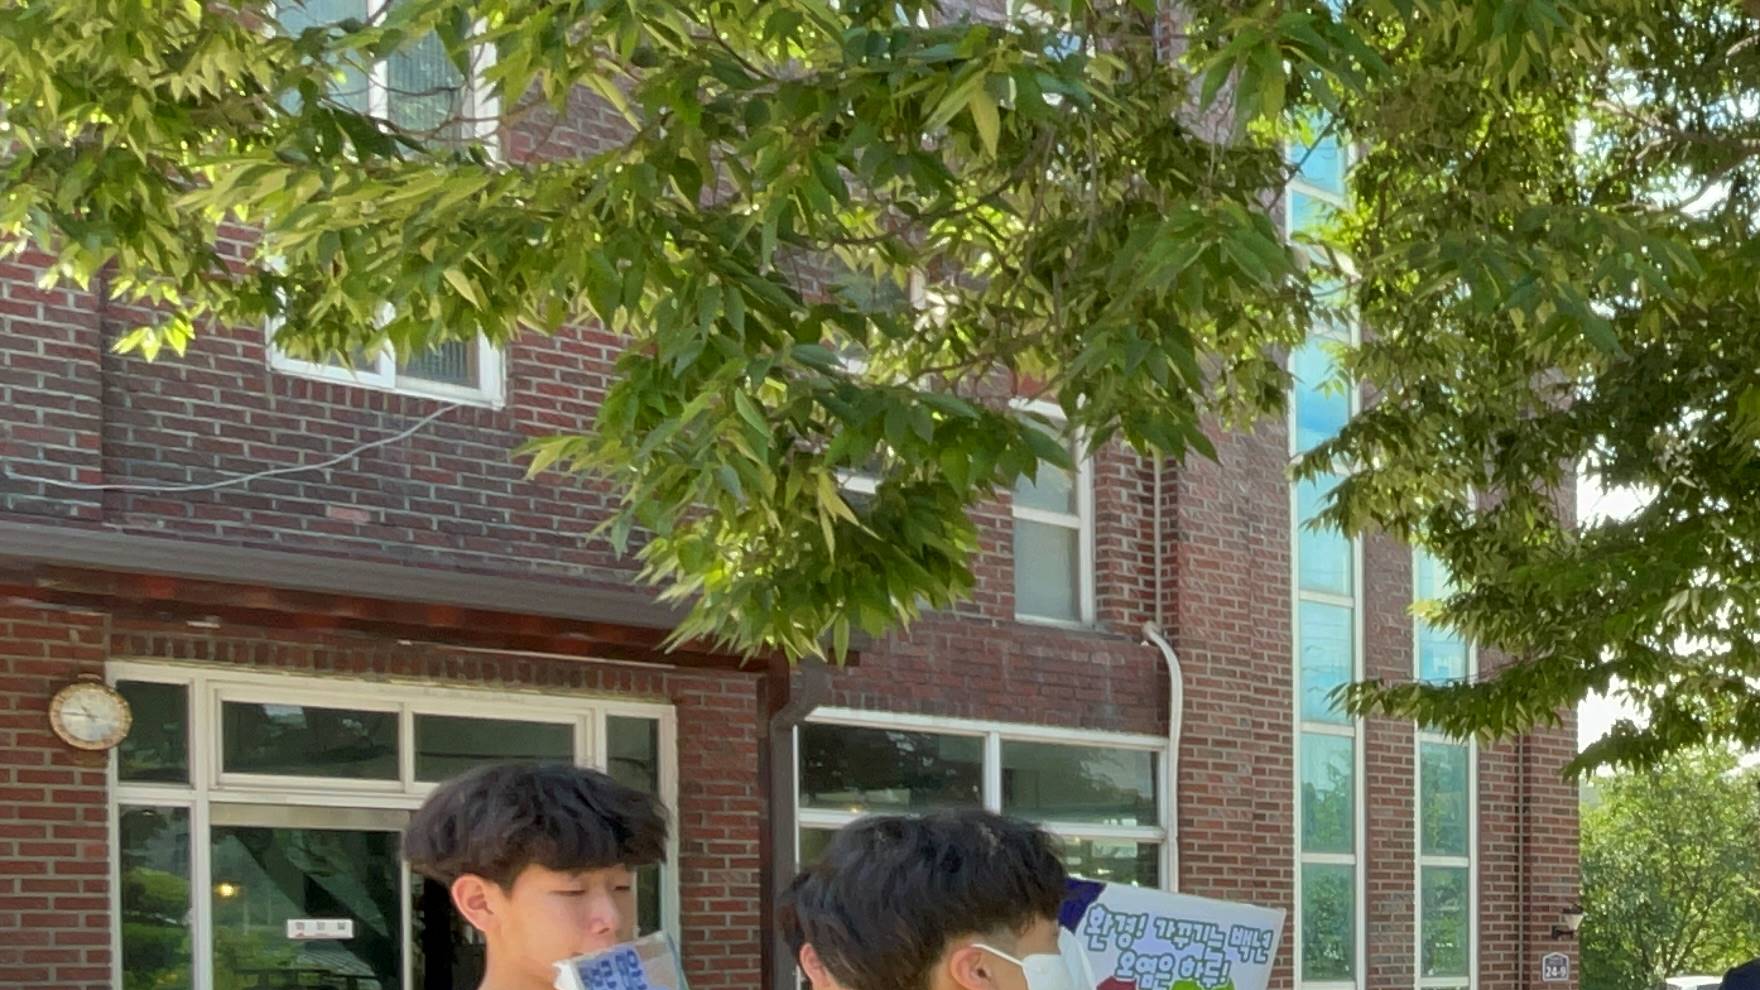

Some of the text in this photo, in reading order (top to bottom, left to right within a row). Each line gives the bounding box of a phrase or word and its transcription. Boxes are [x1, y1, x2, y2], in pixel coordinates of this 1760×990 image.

[1085, 904, 1274, 964] 환경! 가꾸기는 백년
